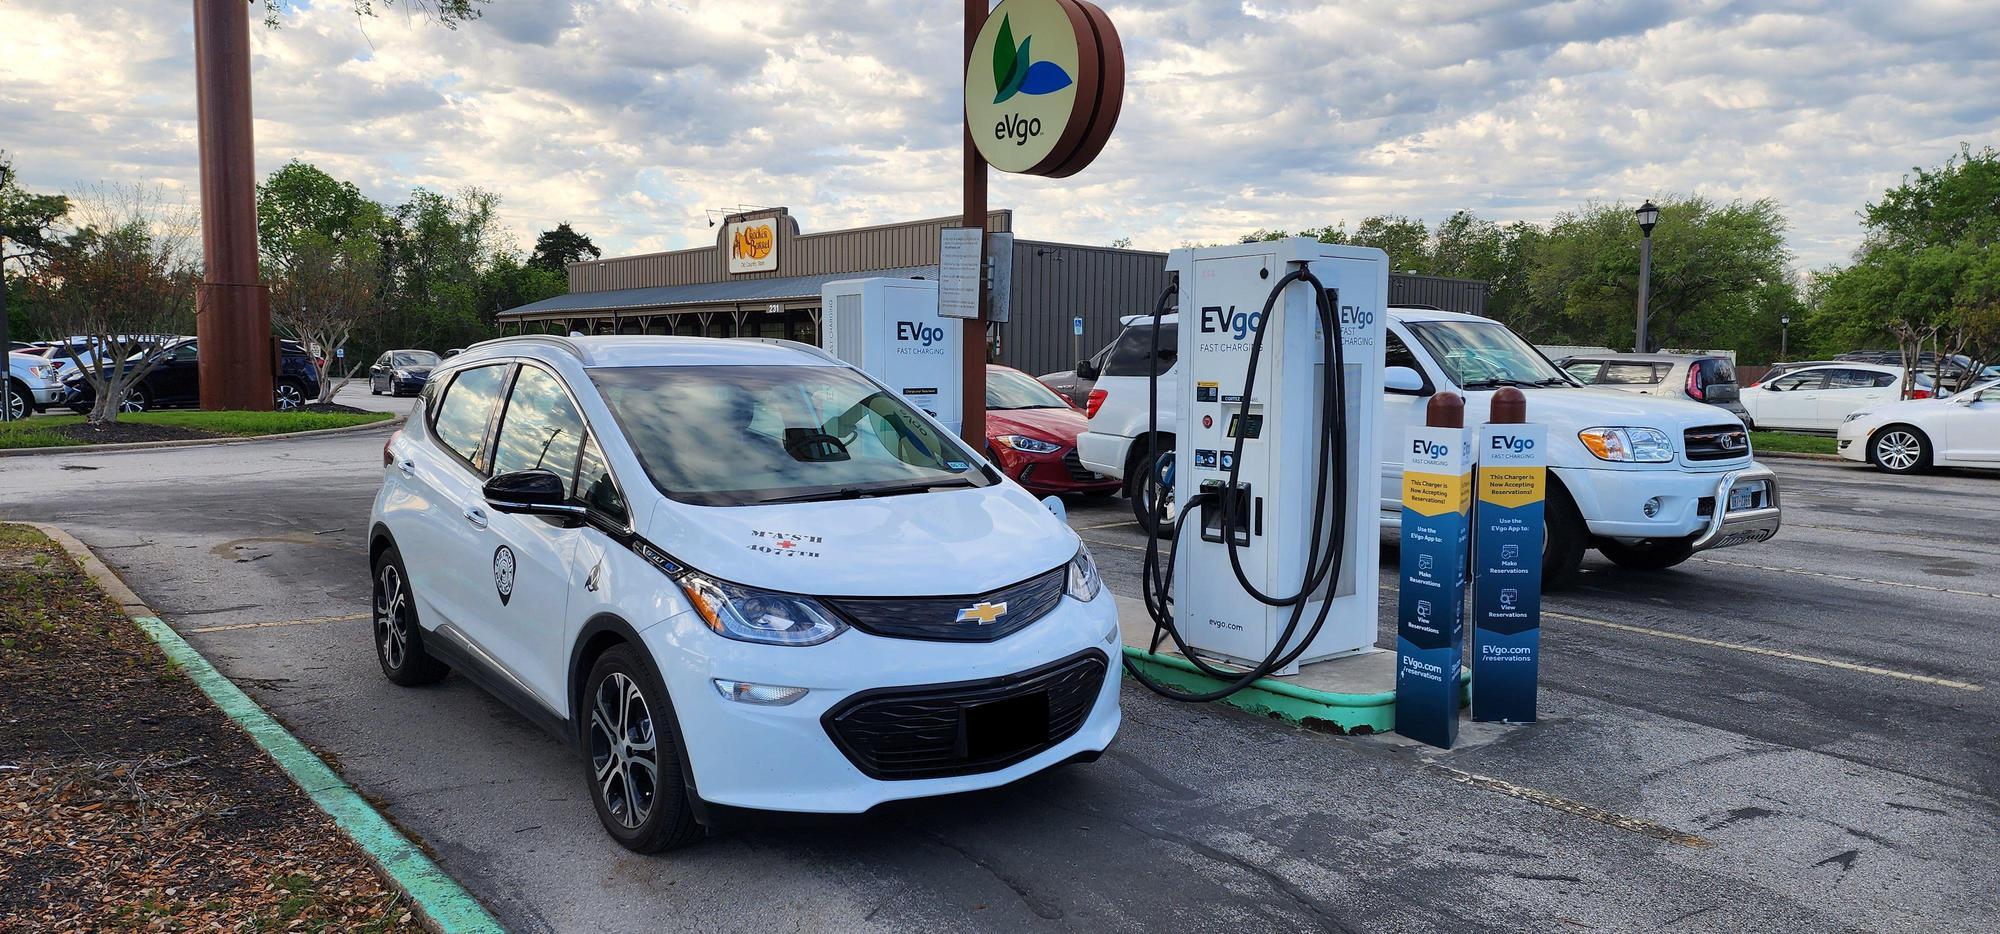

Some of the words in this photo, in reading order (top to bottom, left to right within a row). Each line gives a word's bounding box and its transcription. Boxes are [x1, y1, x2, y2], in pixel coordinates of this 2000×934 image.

[995, 113, 1041, 146] eVgo
[769, 304, 779, 313] 231
[1341, 305, 1374, 330] EVgo
[1201, 305, 1262, 341] EVgo
[897, 321, 944, 347] EVgo
[1341, 327, 1356, 336] FAST
[897, 347, 912, 355] FAST
[913, 347, 945, 355] CHARGING
[1200, 343, 1218, 352] FAST
[1220, 343, 1264, 352] CHARGIG
[1413, 439, 1448, 459] EVgo
[1492, 435, 1535, 453] EVgo
[1504, 474, 1528, 482] Charger
[1422, 480, 1442, 488] Charger
[1504, 481, 1535, 489] Accepting
[1422, 488, 1448, 498] Accepting
[1411, 495, 1446, 505] Reservations!
[1491, 525, 1508, 533] EVgo
[1508, 525, 1521, 533] App
[1410, 533, 1425, 541] EVgo
[1418, 570, 1432, 578] Make
[1409, 576, 1441, 588] Reservations
[1209, 619, 1244, 631] evgo.com
[1417, 616, 1430, 624] View
[1407, 621, 1440, 634] Reservations
[1482, 645, 1531, 656] EVgo.com
[1403, 655, 1442, 674] EVgo.com
[1403, 666, 1442, 682] /reservations
